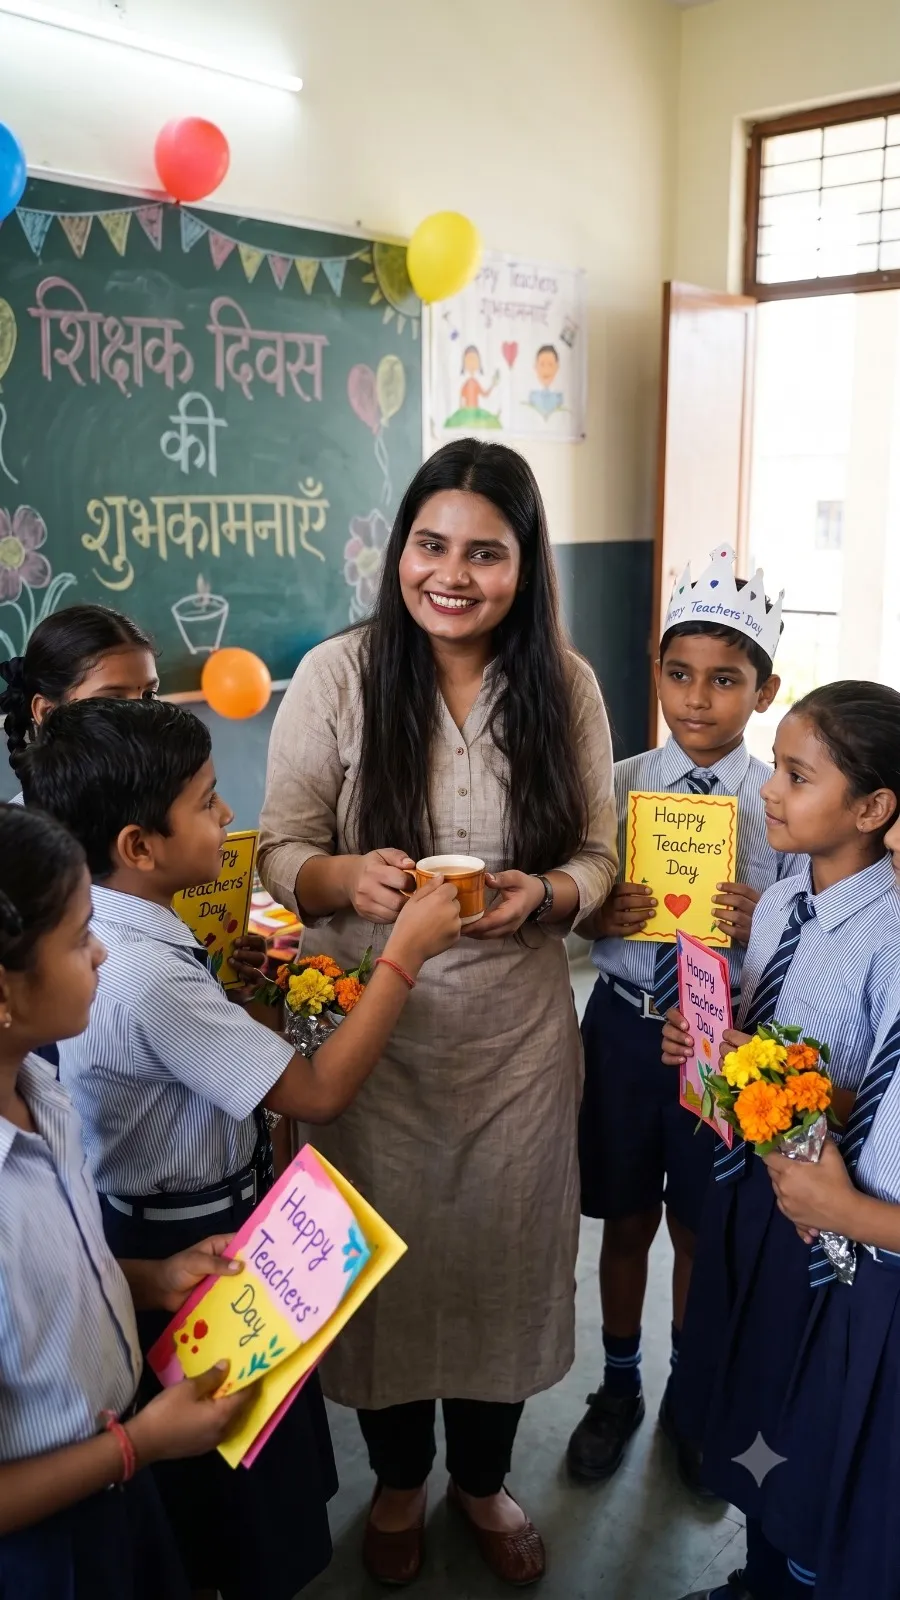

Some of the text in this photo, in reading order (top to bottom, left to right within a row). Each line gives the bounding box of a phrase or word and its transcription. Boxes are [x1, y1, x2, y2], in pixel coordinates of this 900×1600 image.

[28, 276, 330, 401] शिक्षक दिवस
[160, 391, 228, 477] की
[81, 477, 330, 590] शुभकामनाएँ
[744, 614, 763, 637] Day
[654, 806, 706, 832] Happy
[652, 834, 726, 855] Teachers'
[665, 859, 700, 884] Day
[198, 901, 228, 922] Day
[686, 954, 715, 994] Happy
[685, 982, 725, 1022] Teachers'
[695, 1012, 715, 1044] Day
[279, 1186, 336, 1272] Happy
[249, 1228, 320, 1324] Teachers'
[230, 1283, 266, 1348] Day
